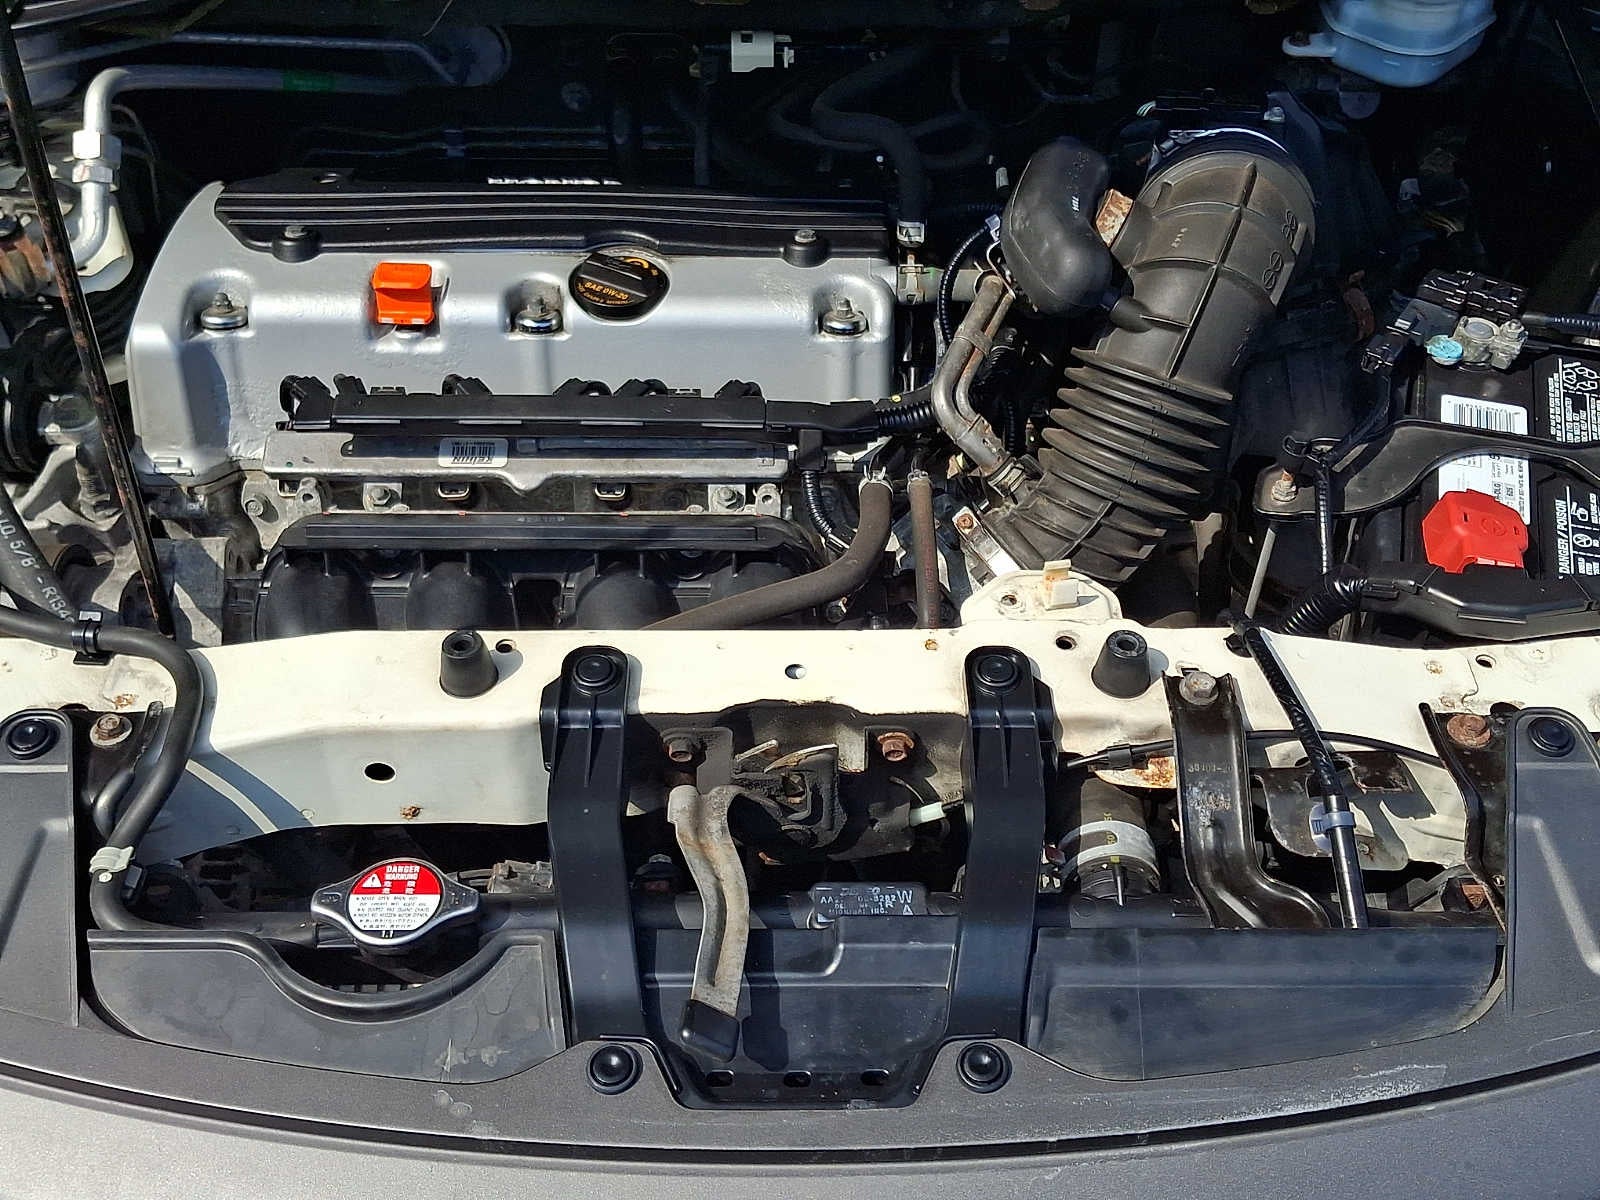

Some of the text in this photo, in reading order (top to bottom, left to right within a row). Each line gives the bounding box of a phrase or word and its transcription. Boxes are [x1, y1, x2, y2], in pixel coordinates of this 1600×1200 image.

[1555, 499, 1568, 531] POISON
[1557, 538, 1570, 574] DANGER
[385, 865, 421, 873] DANGER
